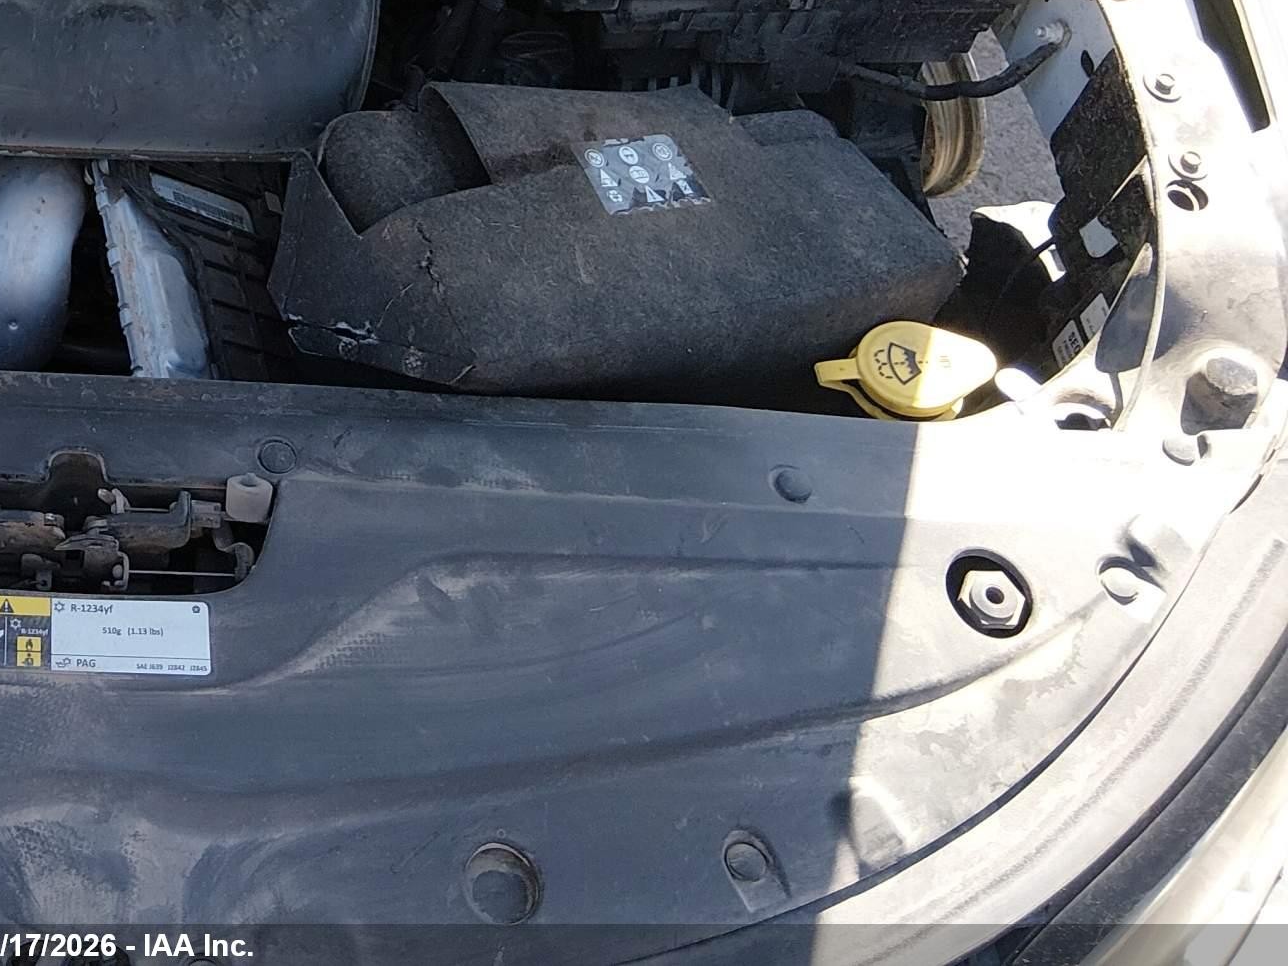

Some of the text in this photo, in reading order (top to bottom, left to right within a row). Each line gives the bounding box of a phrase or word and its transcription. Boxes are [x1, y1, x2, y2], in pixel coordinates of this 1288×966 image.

[70, 603, 114, 615] R-1234yf
[102, 626, 164, 637] 510g (1.13 lbs)
[76, 658, 96, 668] PAG
